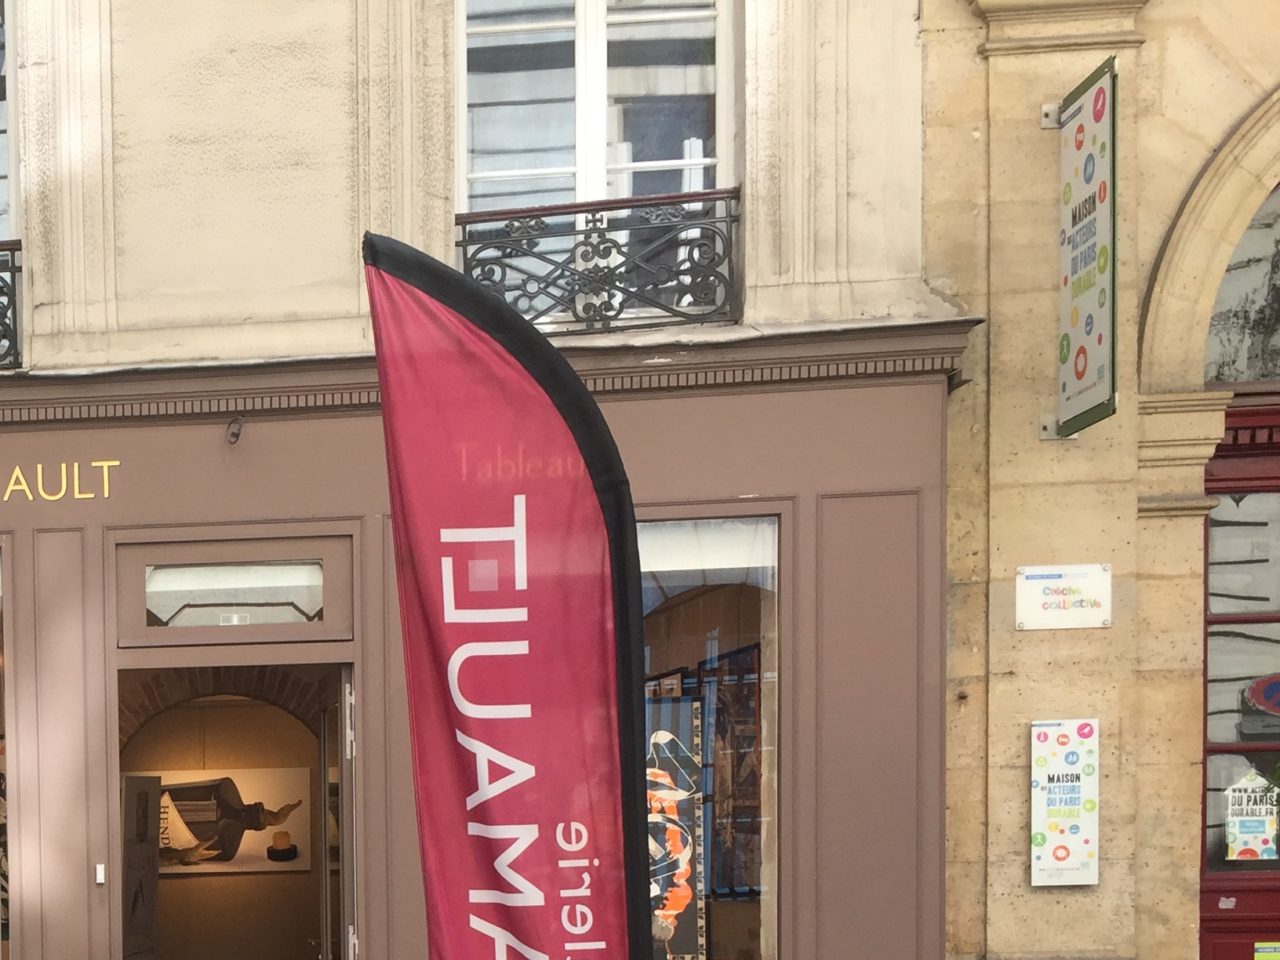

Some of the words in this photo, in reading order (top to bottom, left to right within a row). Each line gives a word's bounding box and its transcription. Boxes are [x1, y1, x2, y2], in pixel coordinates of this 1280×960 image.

[1071, 191, 1097, 228] MAISON
[1080, 242, 1097, 271] PARIS
[1047, 773, 1081, 784] MAISON
[1047, 785, 1081, 795] ACTEURS
[1059, 796, 1081, 806] PARIS
[1231, 796, 1243, 807] DU
[1246, 795, 1275, 807] PARIS
[1230, 808, 1274, 818] DURABLE.FR
